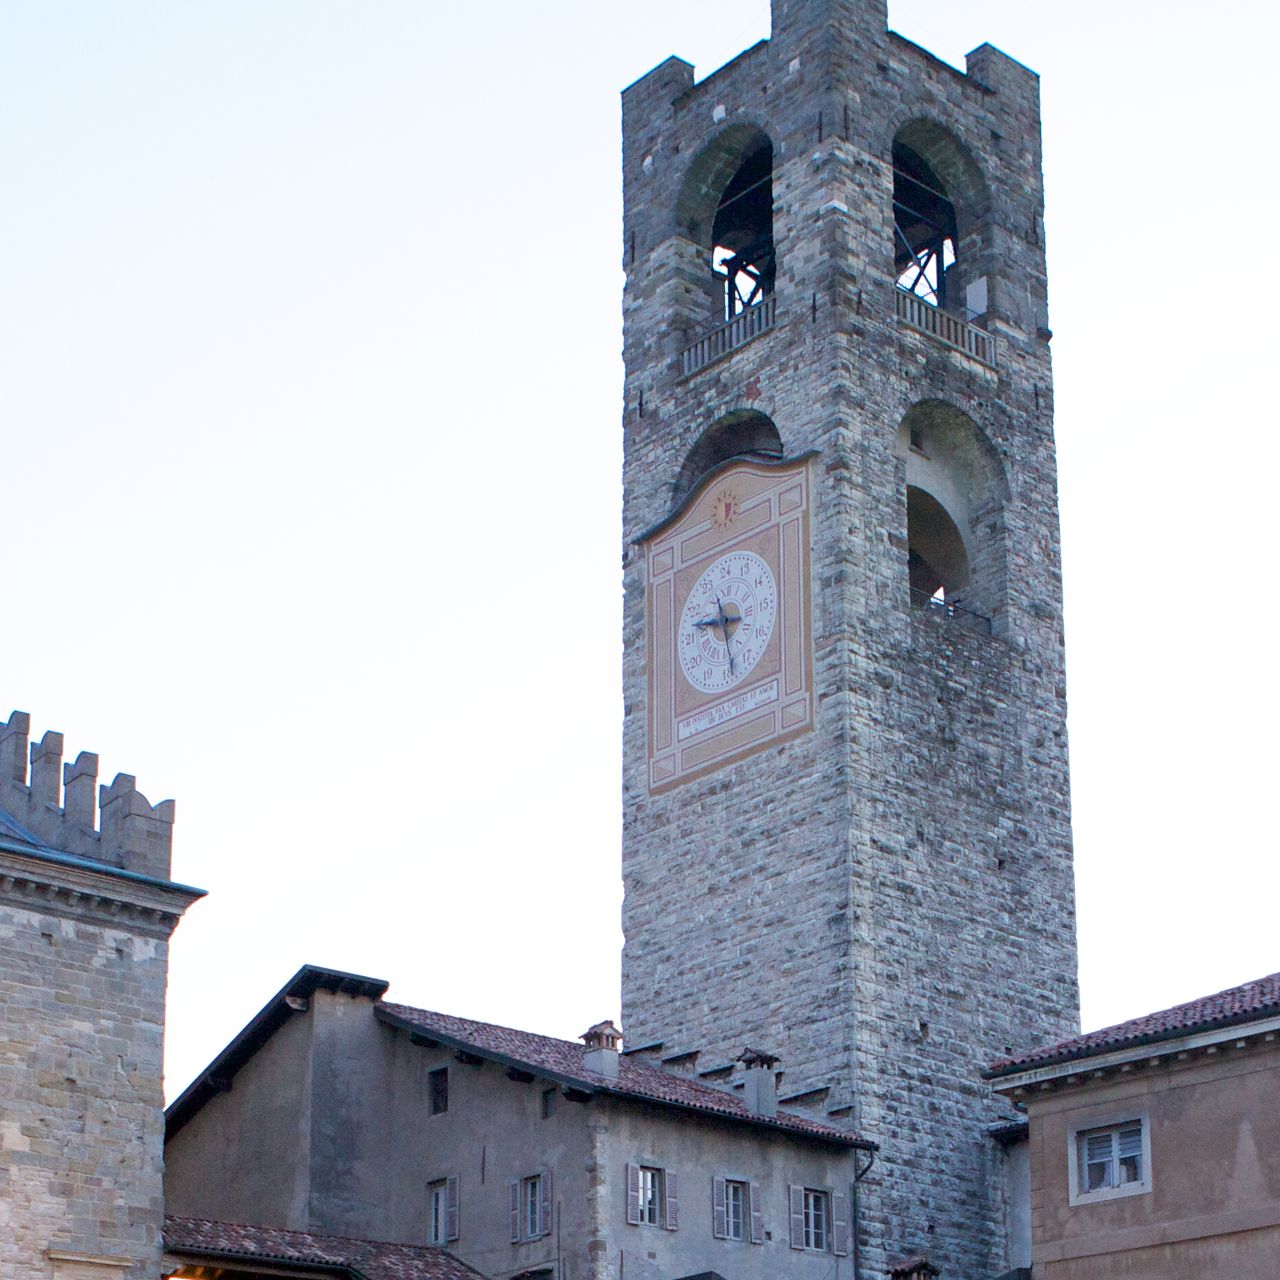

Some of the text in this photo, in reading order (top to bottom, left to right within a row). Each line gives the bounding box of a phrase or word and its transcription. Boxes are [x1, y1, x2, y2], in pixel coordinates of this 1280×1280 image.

[754, 575, 763, 589] 14
[760, 598, 768, 612] 15
[755, 625, 764, 639] 16
[685, 633, 694, 646] 21
[690, 654, 701, 670] 20
[743, 649, 752, 664] 17
[703, 667, 713, 681] 19
